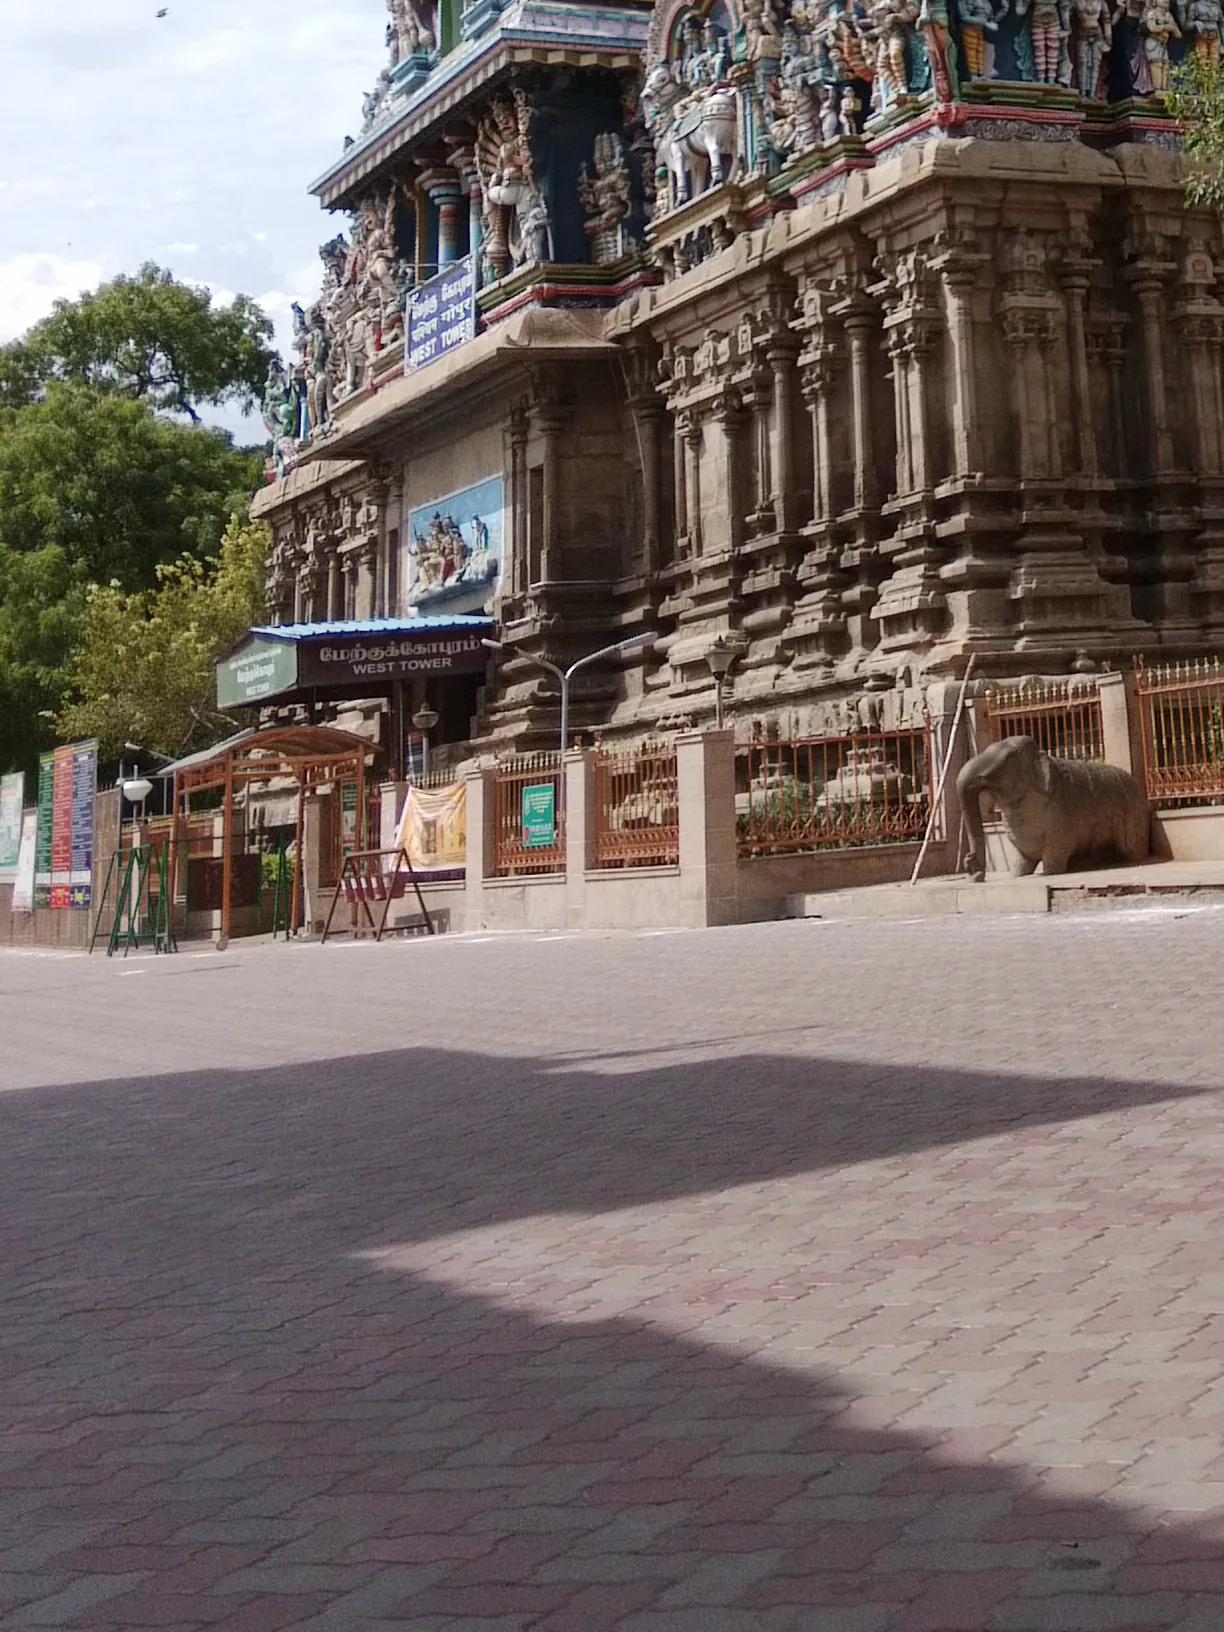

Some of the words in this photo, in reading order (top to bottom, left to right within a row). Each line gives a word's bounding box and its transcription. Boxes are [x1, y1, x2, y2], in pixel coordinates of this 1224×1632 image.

[409, 336, 438, 364] WEST
[440, 318, 473, 349] TOWER
[352, 661, 395, 676] WEST
[401, 656, 453, 672] TOWER
